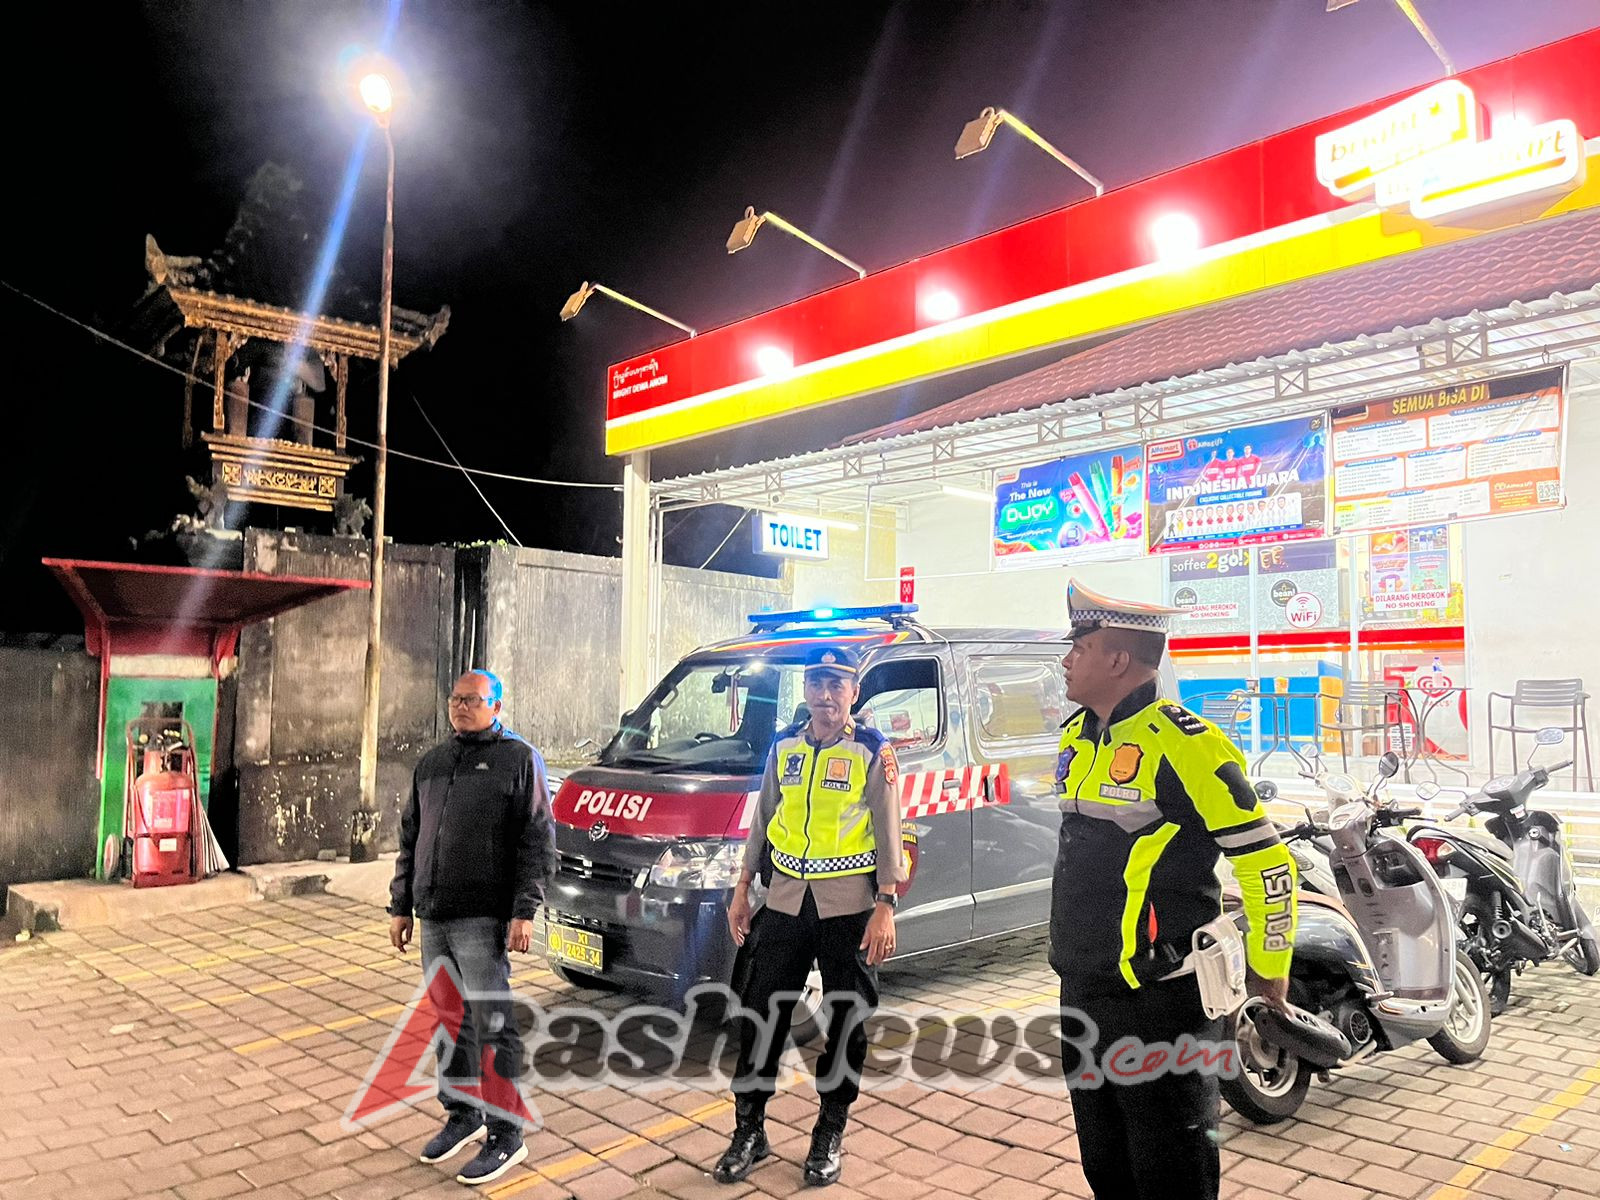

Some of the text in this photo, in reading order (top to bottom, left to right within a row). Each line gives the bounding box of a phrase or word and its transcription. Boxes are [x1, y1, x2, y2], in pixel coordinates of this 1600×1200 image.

[1392, 394, 1434, 416] SEMUA
[1471, 384, 1485, 401] DI
[1166, 476, 1248, 500] INDONESIA
[1248, 468, 1300, 489] JUARA
[769, 522, 823, 552] TOILET
[1375, 592, 1446, 603] DILARANG MEROKOK
[1398, 601, 1436, 609] SMOKING
[1291, 611, 1317, 622] WiFi
[574, 790, 653, 821] POLISI
[1261, 863, 1293, 952] POLISI
[577, 932, 589, 945] XI
